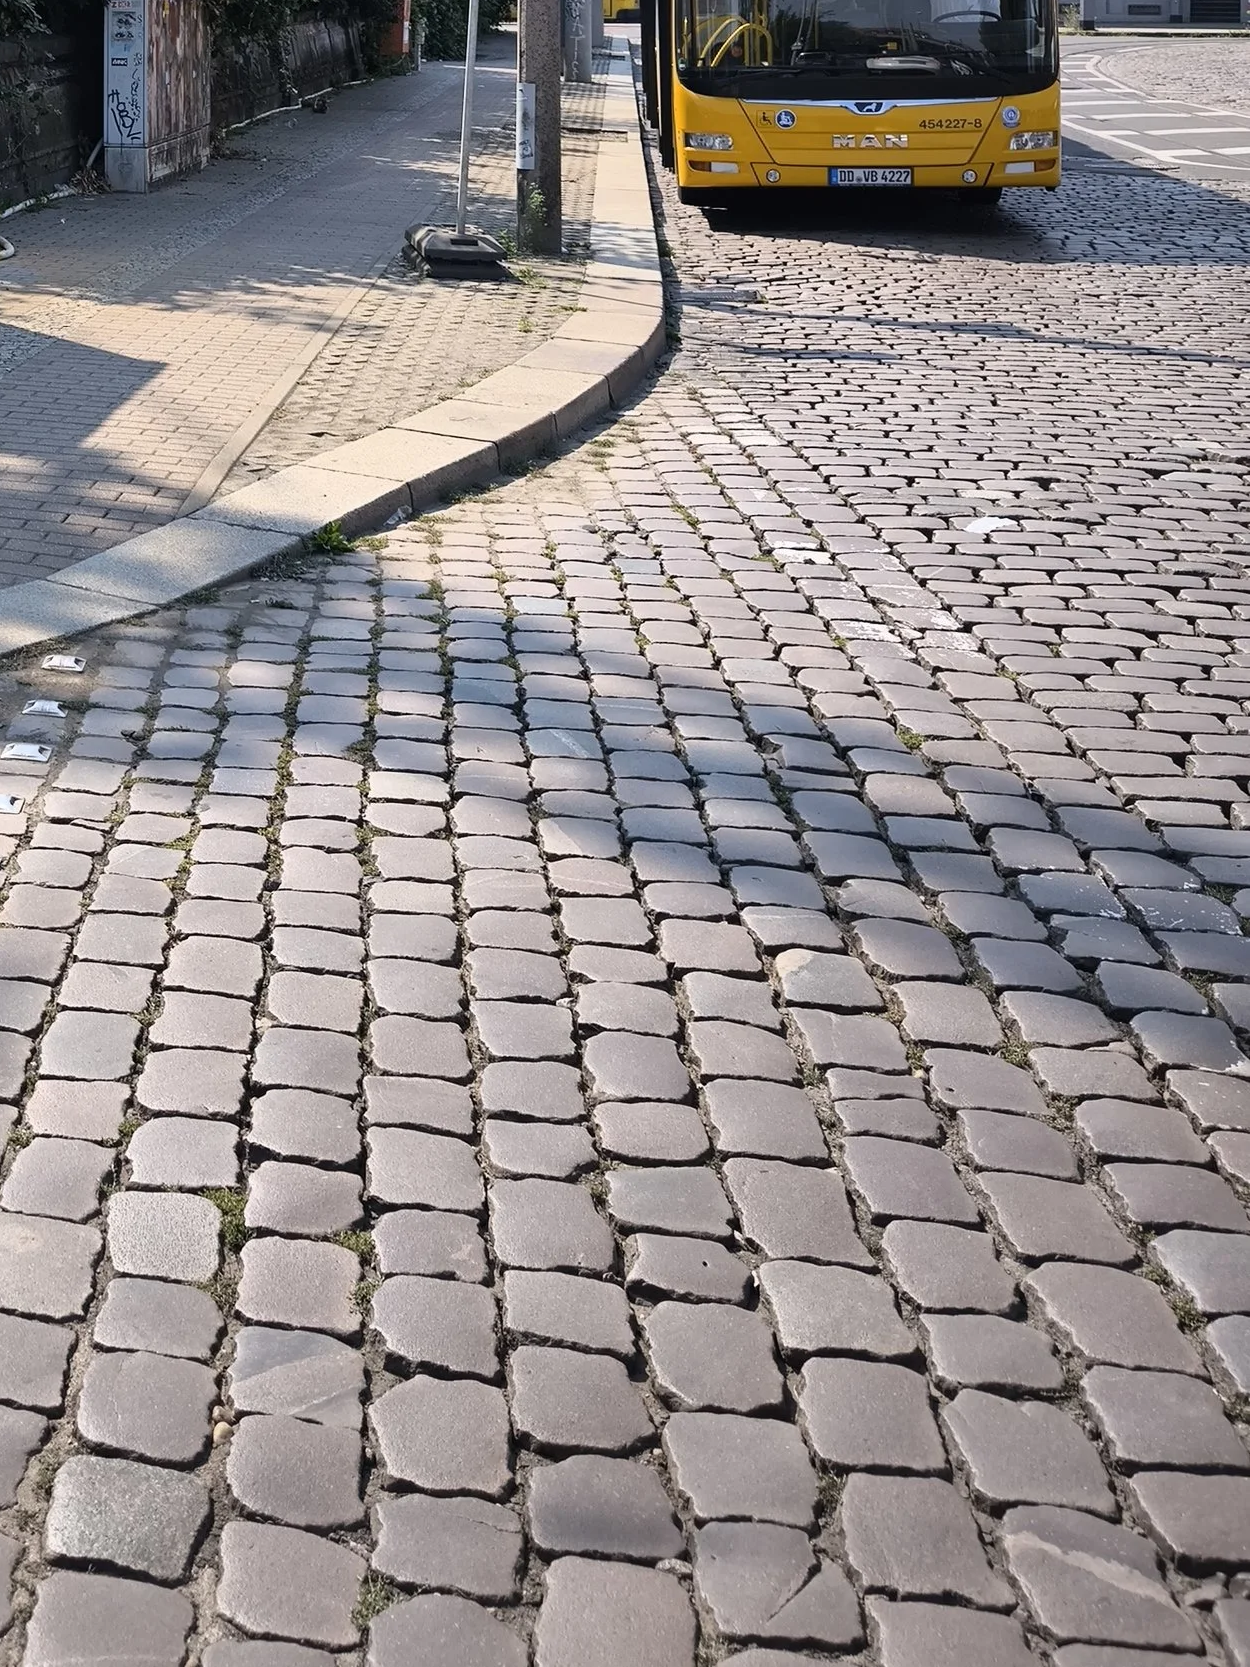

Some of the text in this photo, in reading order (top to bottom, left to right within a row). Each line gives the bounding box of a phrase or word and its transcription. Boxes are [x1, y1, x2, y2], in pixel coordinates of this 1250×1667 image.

[919, 118, 983, 129] 454227-8
[832, 134, 910, 149] MAN
[839, 170, 911, 183] DD VB 4227
